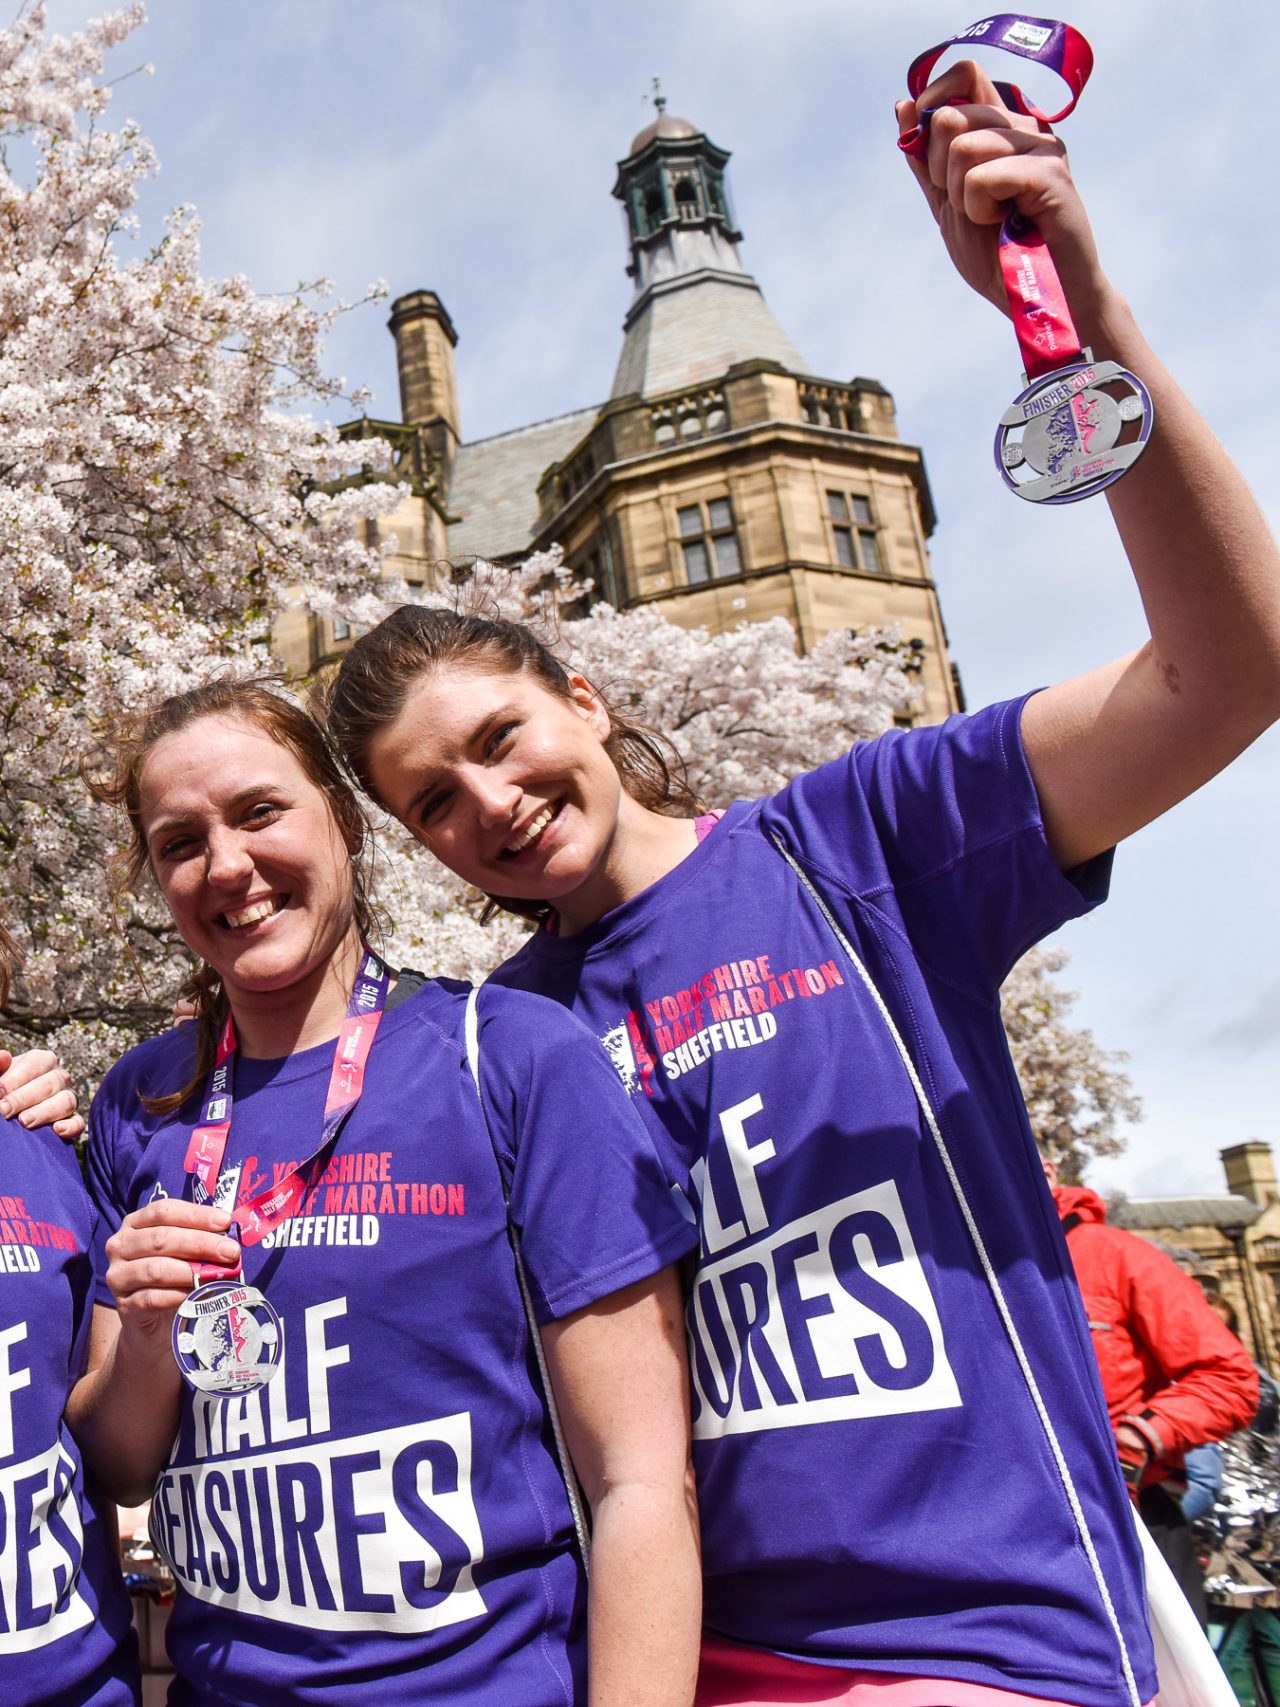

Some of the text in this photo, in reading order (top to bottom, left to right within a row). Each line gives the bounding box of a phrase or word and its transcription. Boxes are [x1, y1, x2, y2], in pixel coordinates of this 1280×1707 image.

[1022, 367, 1096, 418] FINISHER 2015
[358, 983, 380, 1009] 2015
[645, 955, 775, 1027] YORKSHIRE
[654, 959, 845, 1055] HALF MARATHON
[662, 1011, 777, 1080] SHEFFIELD
[211, 1066, 227, 1093] 2015
[323, 1182, 465, 1217] MARATHON
[261, 1214, 380, 1250] SHEFFIELD
[194, 1289, 247, 1316] FINISHER 2015
[692, 1210, 934, 1419] URES
